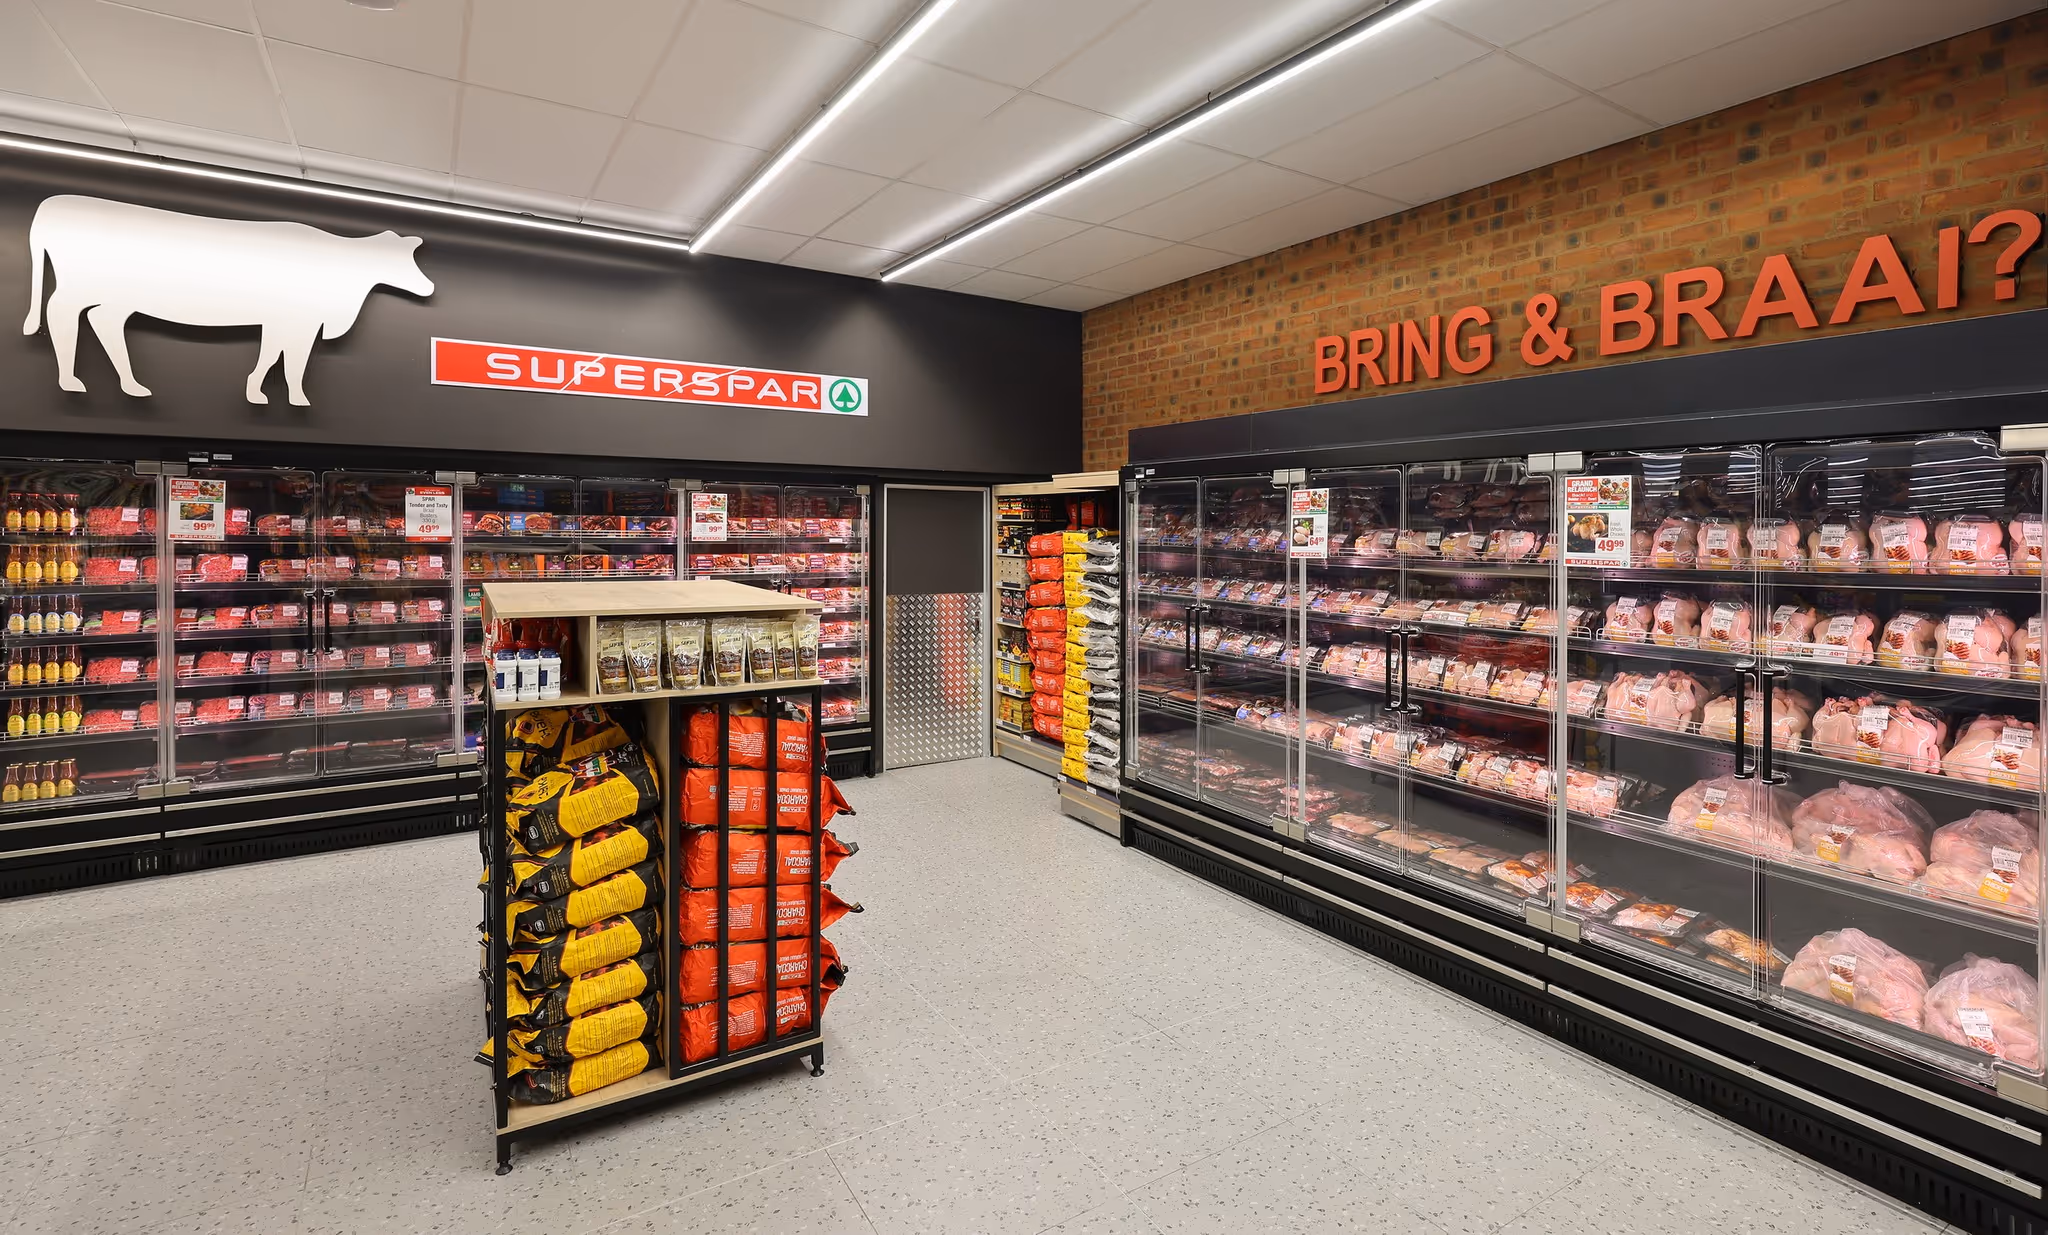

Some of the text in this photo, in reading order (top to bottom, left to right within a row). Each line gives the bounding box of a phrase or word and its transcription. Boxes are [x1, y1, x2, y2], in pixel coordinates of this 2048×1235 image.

[1314, 208, 2045, 395] BRING & BRAAI?
[486, 352, 819, 405] SUPERSPAR
[777, 793, 808, 805] CHARCOA
[784, 856, 813, 867] HARCOAL
[1983, 879, 2009, 893] CHICKEN
[776, 960, 808, 974] CHARCOA
[776, 1001, 807, 1018] CHARCOA
